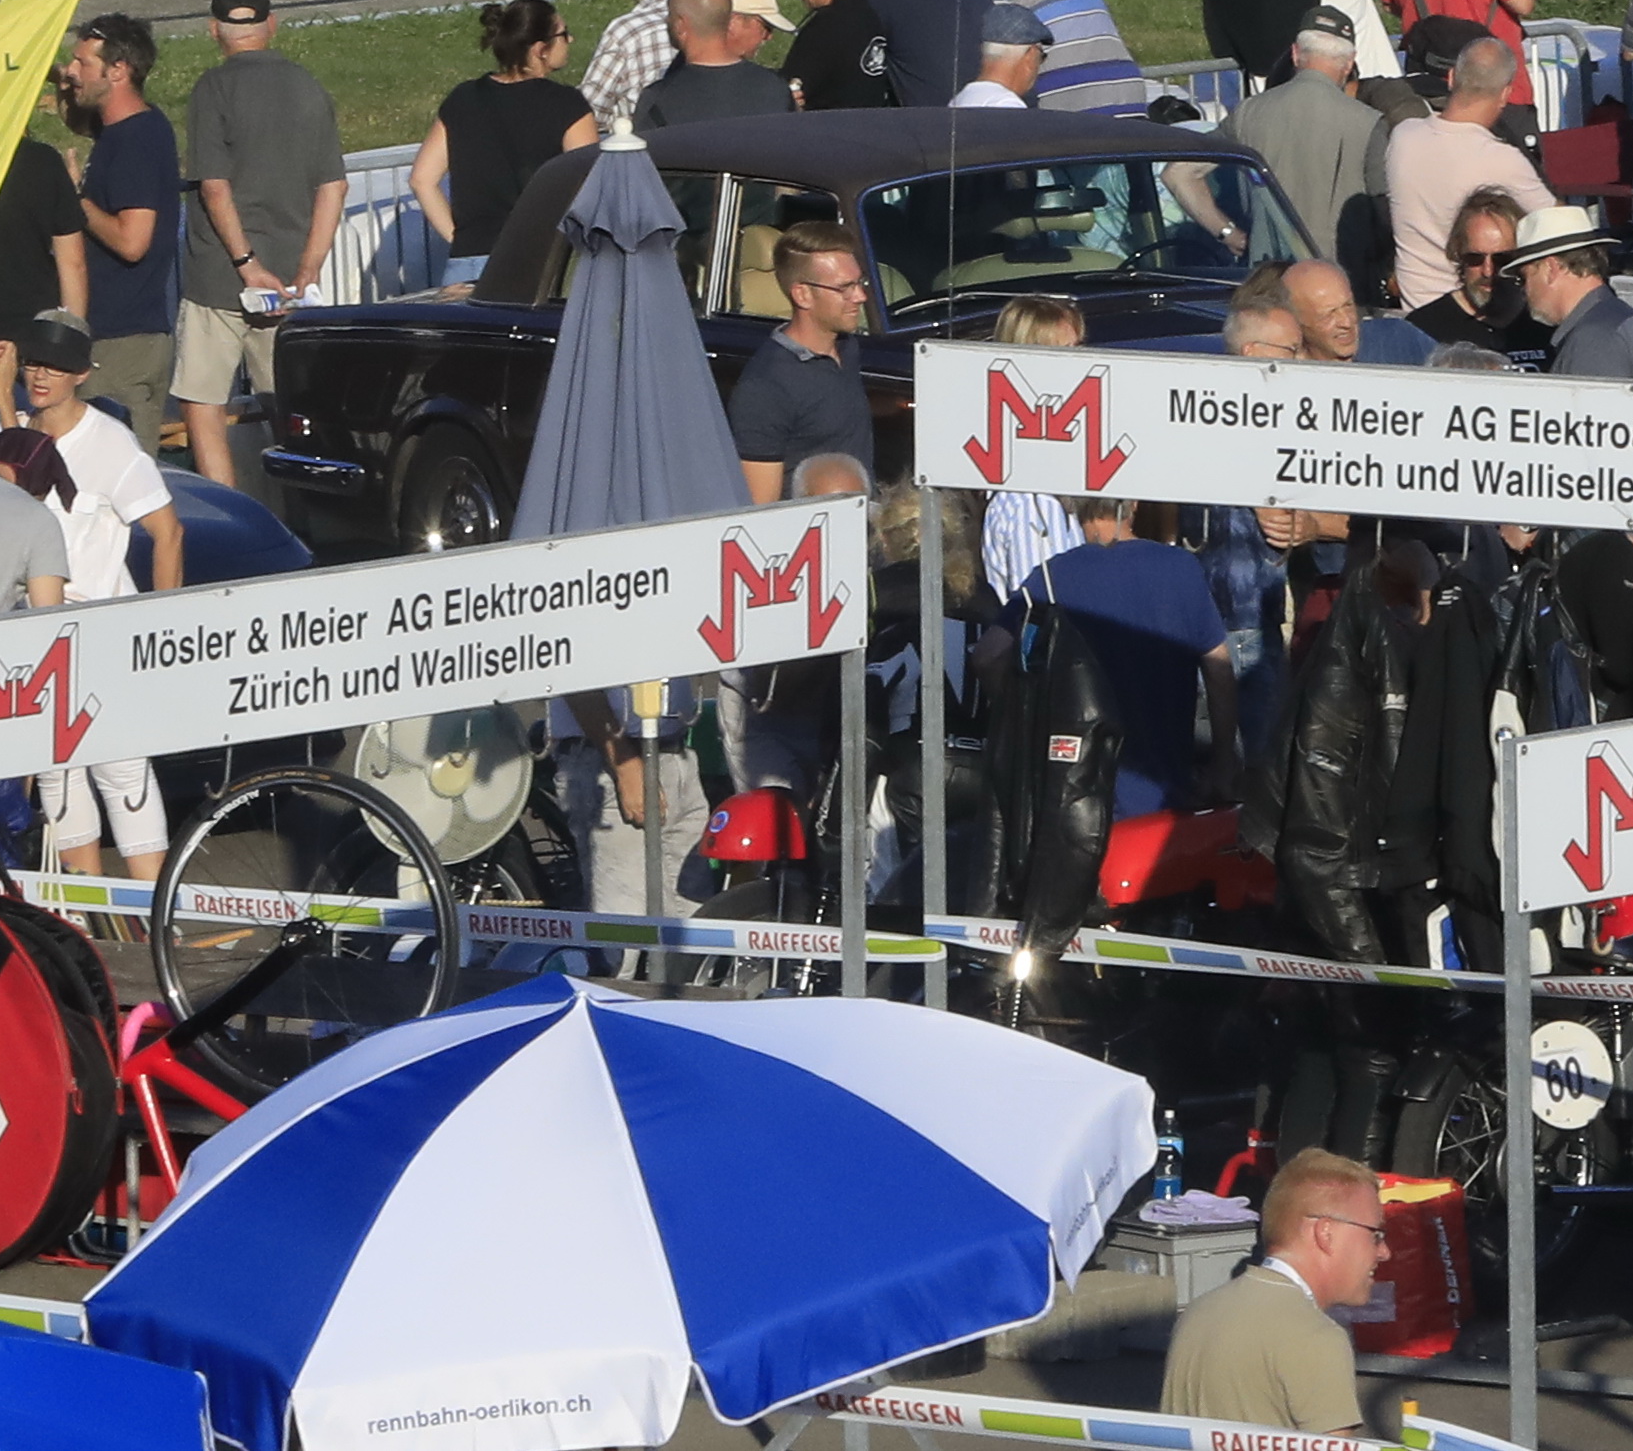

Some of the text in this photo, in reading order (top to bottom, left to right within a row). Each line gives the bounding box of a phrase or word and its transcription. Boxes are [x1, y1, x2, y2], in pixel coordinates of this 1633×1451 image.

[1168, 389, 1283, 431] Mösler
[1297, 397, 1318, 432] &
[1331, 397, 1423, 439] Meier
[1444, 405, 1498, 445] AG
[1275, 448, 1382, 488] Zürich
[1395, 453, 1459, 495] und
[131, 564, 669, 672] Mösler & Meier AG Elektroanlagen
[228, 634, 572, 715] Zürich und Wallisellen
[194, 893, 296, 920] RAIFFEISEN
[468, 912, 573, 940] RAIFFEISEN
[747, 930, 842, 954] RAIFFEISE
[1256, 956, 1365, 983] RAIFFEISEN
[1544, 1055, 1583, 1103] 60
[367, 1392, 593, 1437] rennbahn-oerlikon.ch
[816, 1391, 965, 1427] RAIFFEISEN
